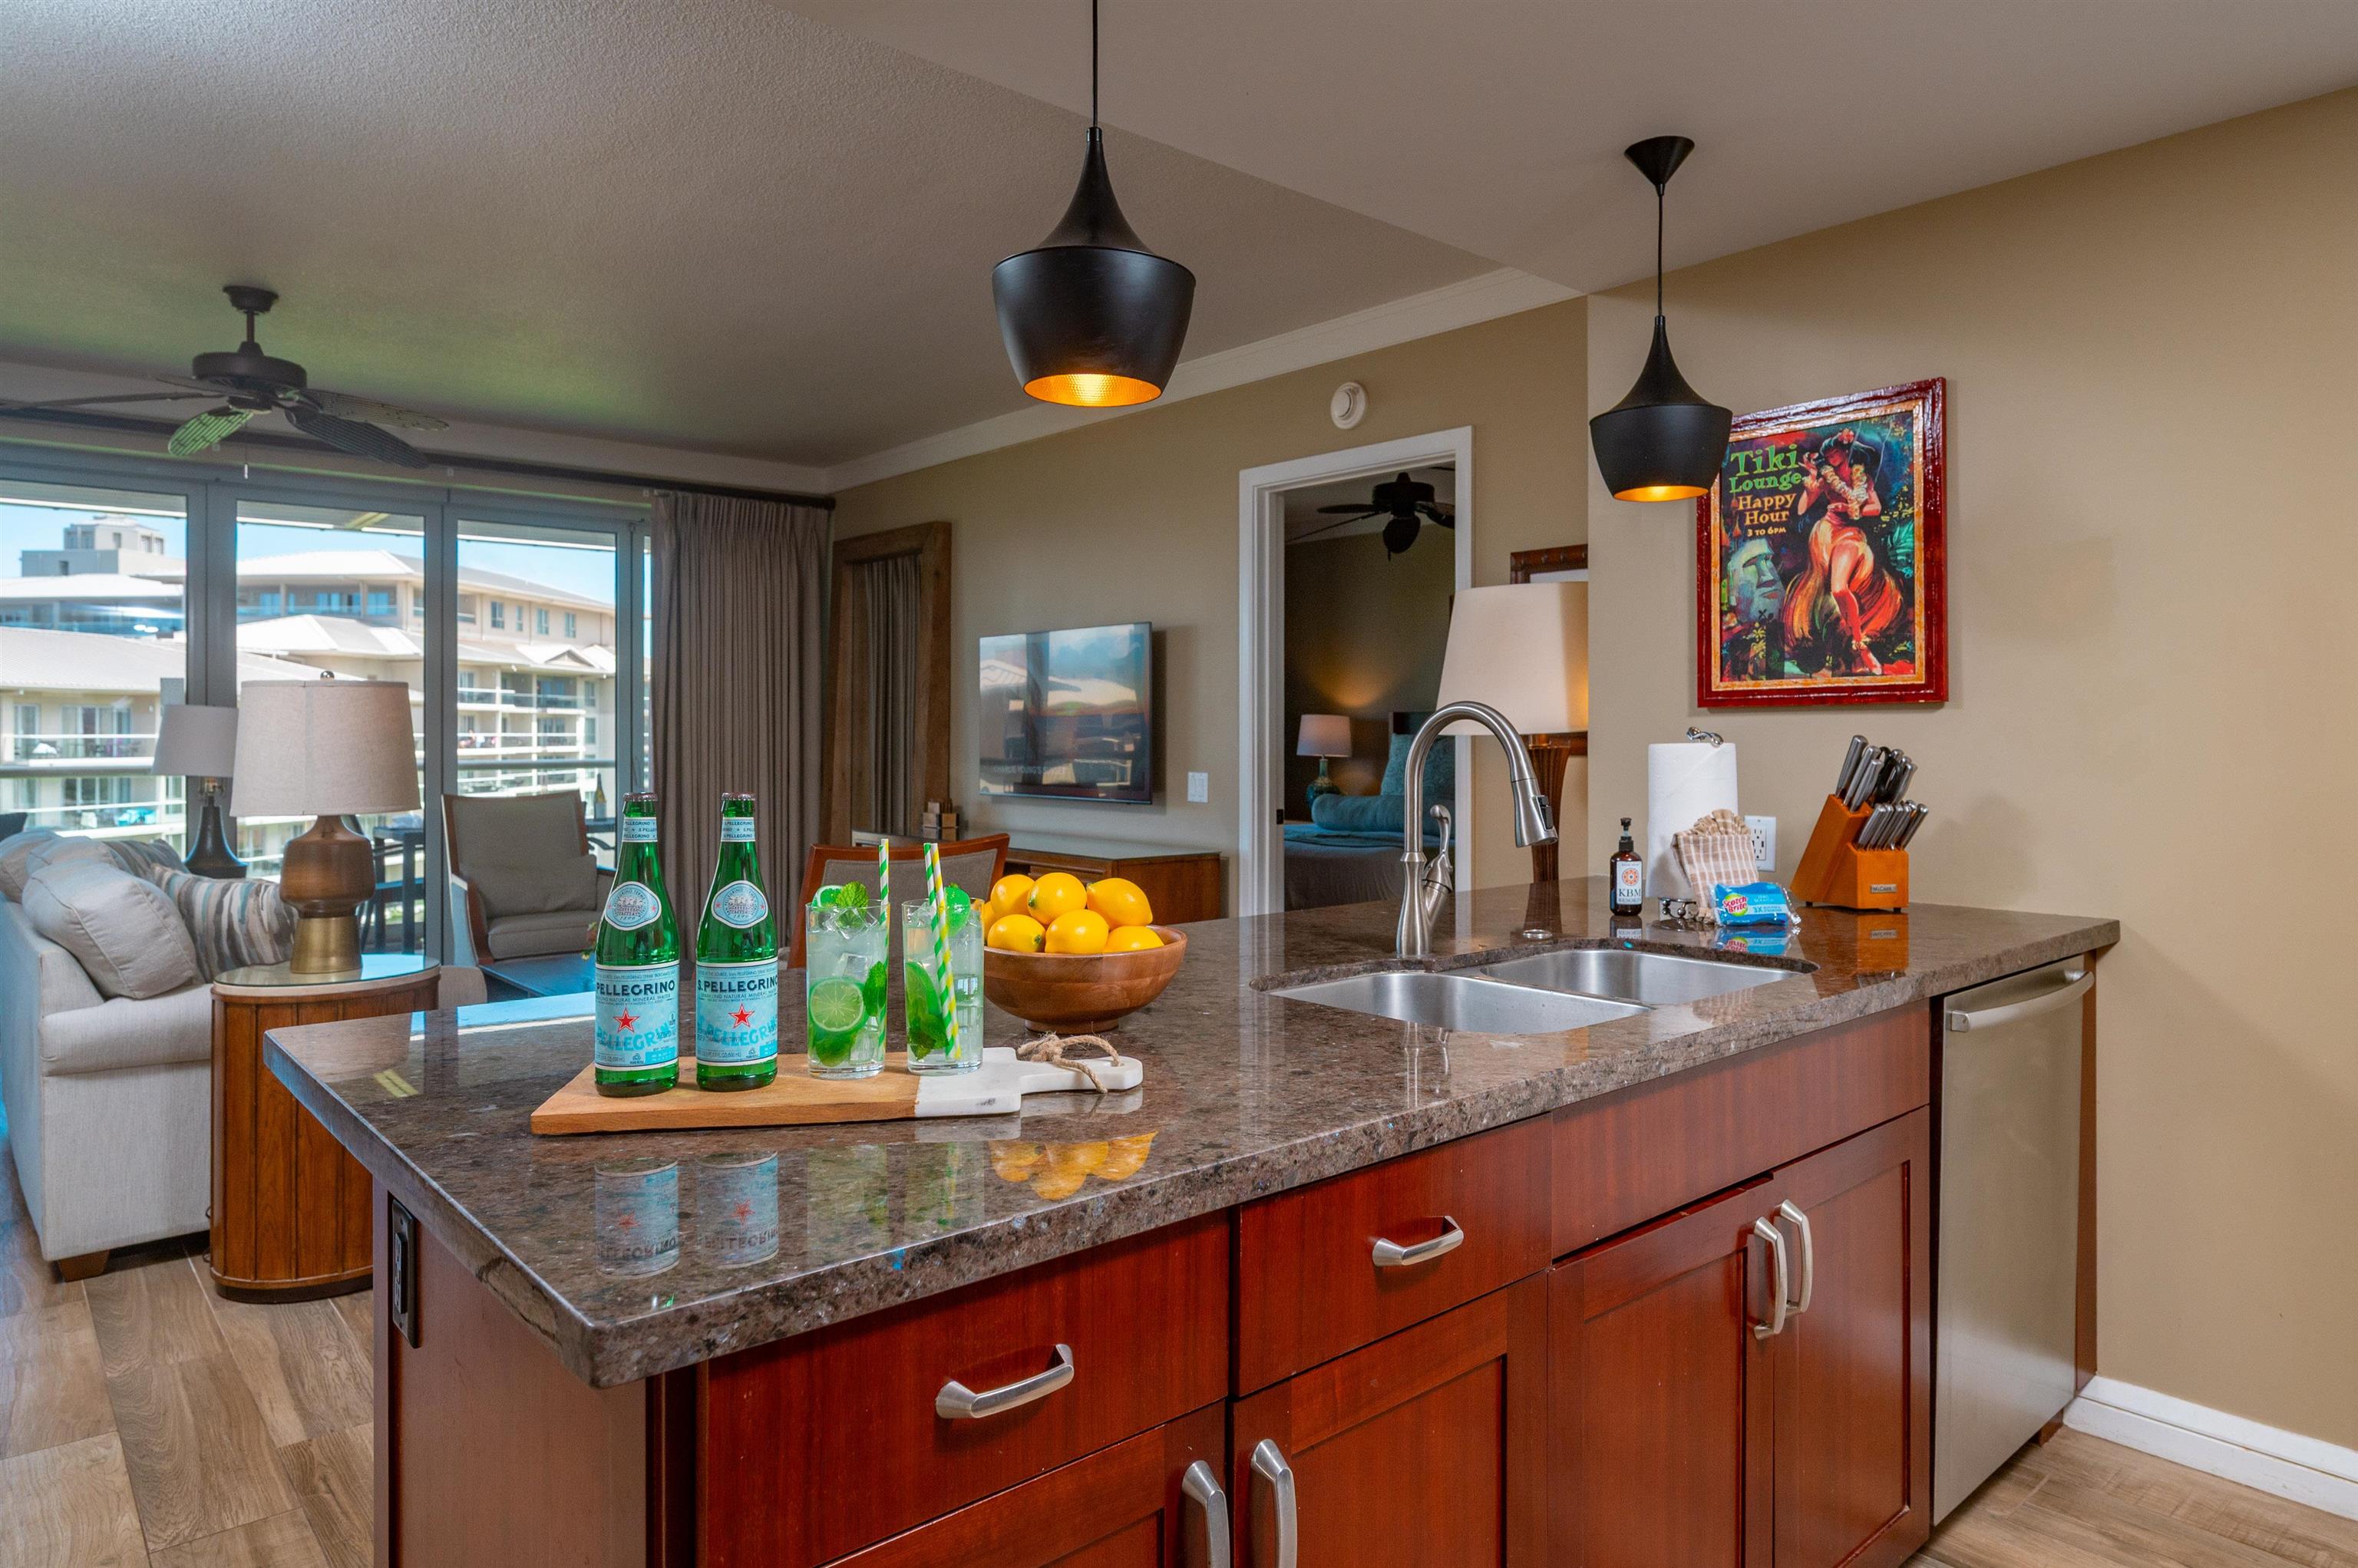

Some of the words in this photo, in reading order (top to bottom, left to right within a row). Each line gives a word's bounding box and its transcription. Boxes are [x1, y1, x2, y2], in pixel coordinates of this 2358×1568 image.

[1730, 444, 1799, 477] Tiki
[1729, 470, 1802, 494] Lounge
[1738, 493, 1797, 511] Happy
[1743, 510, 1790, 526] Hour
[1746, 528, 1753, 537] 3
[1755, 528, 1765, 536] TO
[1767, 526, 1787, 535] 6PM
[1619, 888, 1641, 897] KBM
[1723, 896, 1747, 907] Scotch
[1728, 903, 1747, 913] Brite
